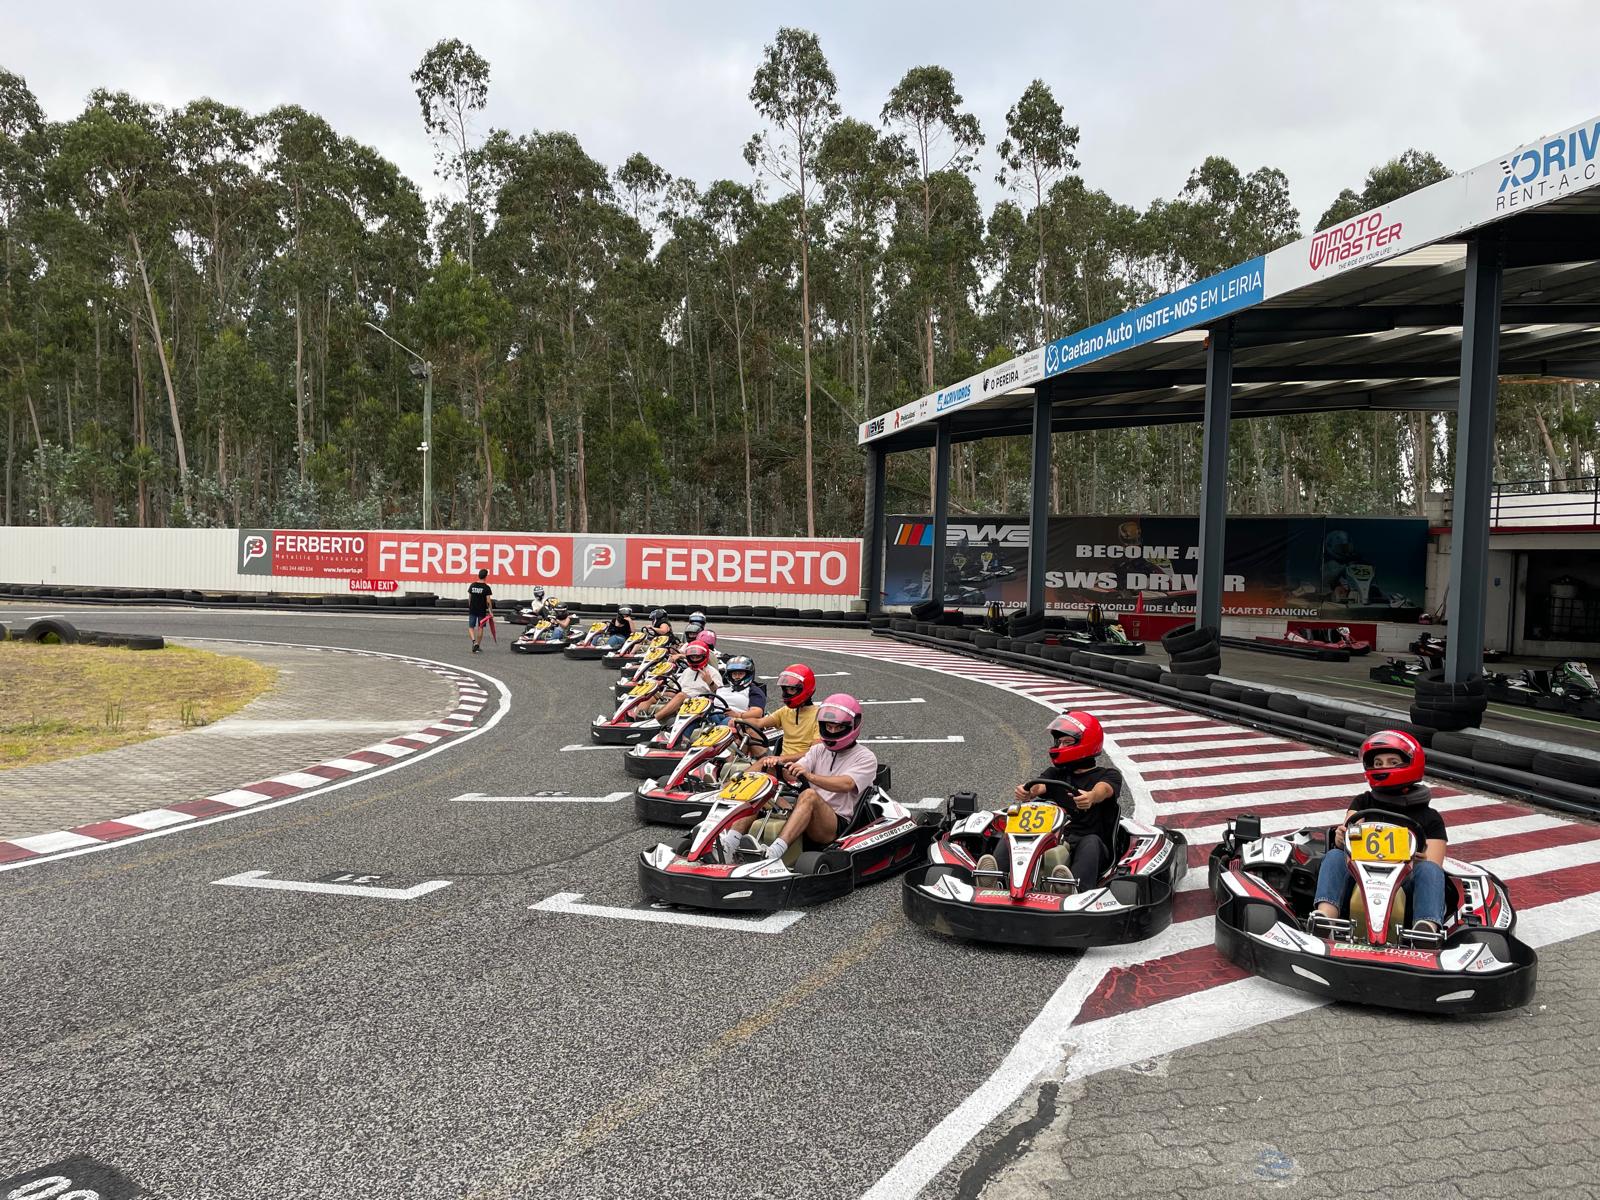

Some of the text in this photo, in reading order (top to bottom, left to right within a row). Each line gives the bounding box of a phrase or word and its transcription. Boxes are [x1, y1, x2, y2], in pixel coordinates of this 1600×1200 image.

[1061, 270, 1262, 363] Caetano Auto VISITE-NOS EM LEIRIA
[996, 370, 1019, 388] PEREIRA
[275, 535, 365, 554] FERBERTO
[1076, 545, 1180, 559] BECOME
[379, 540, 561, 578] FERBERTO
[641, 547, 847, 586] FERBERTO
[323, 566, 363, 575] www.ferberto.pt
[350, 579, 372, 590] SAÍDA
[377, 581, 395, 591] EXIT
[1045, 572, 1245, 592] SWS DRIVR
[1265, 607, 1318, 616] RANKING
[1019, 810, 1046, 829] 85
[1365, 831, 1395, 855] 61
